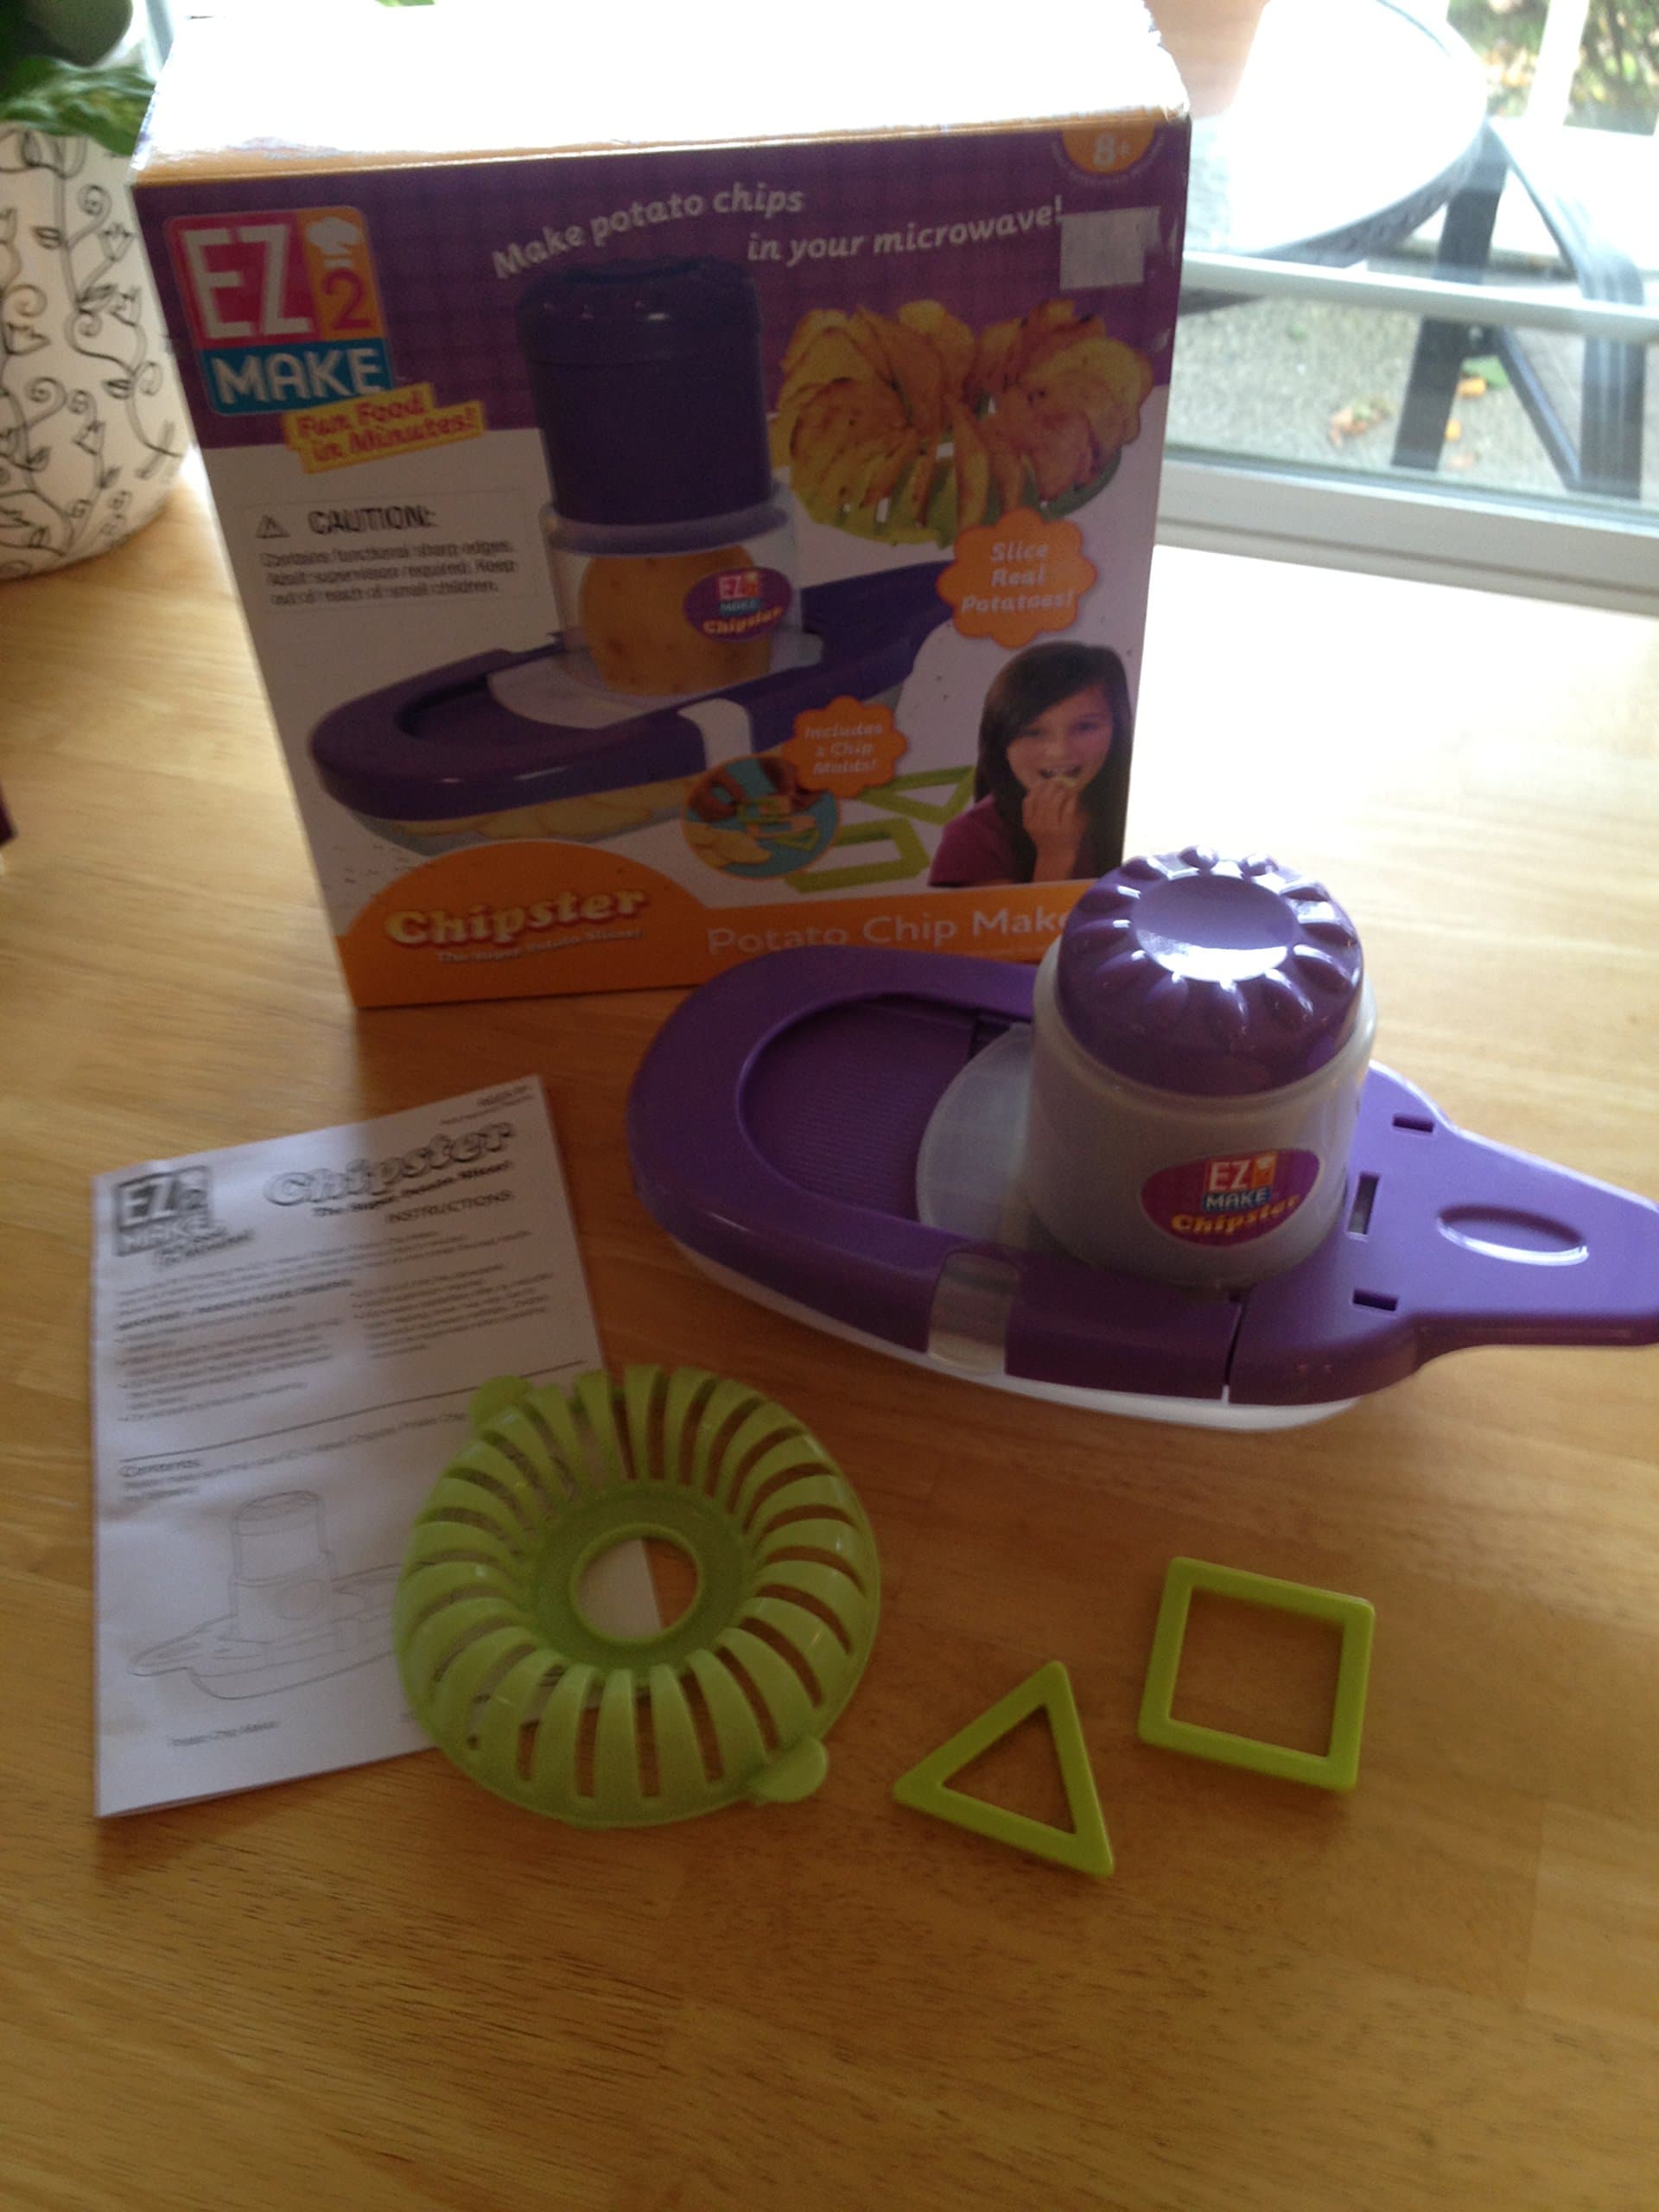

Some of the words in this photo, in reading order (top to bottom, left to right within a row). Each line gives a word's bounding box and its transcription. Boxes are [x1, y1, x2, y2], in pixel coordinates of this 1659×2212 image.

[493, 226, 584, 280] Make
[590, 194, 702, 246] potato
[713, 182, 804, 213] chips
[747, 232, 780, 263] in
[786, 235, 864, 266] your
[873, 194, 1063, 254] microwave!
[183, 223, 313, 340] EZ
[325, 270, 373, 330] 2
[212, 348, 385, 404] MAKE
[356, 389, 425, 426] Food
[990, 542, 1049, 563] Slice
[961, 591, 1073, 614] Potatoes!
[385, 891, 647, 945] Chipster
[707, 927, 849, 954] Potato
[863, 916, 957, 946] Chip
[263, 1122, 516, 1205] Chipster
[1211, 1160, 1252, 1191] EZ
[1206, 1190, 1267, 1210] MAKE
